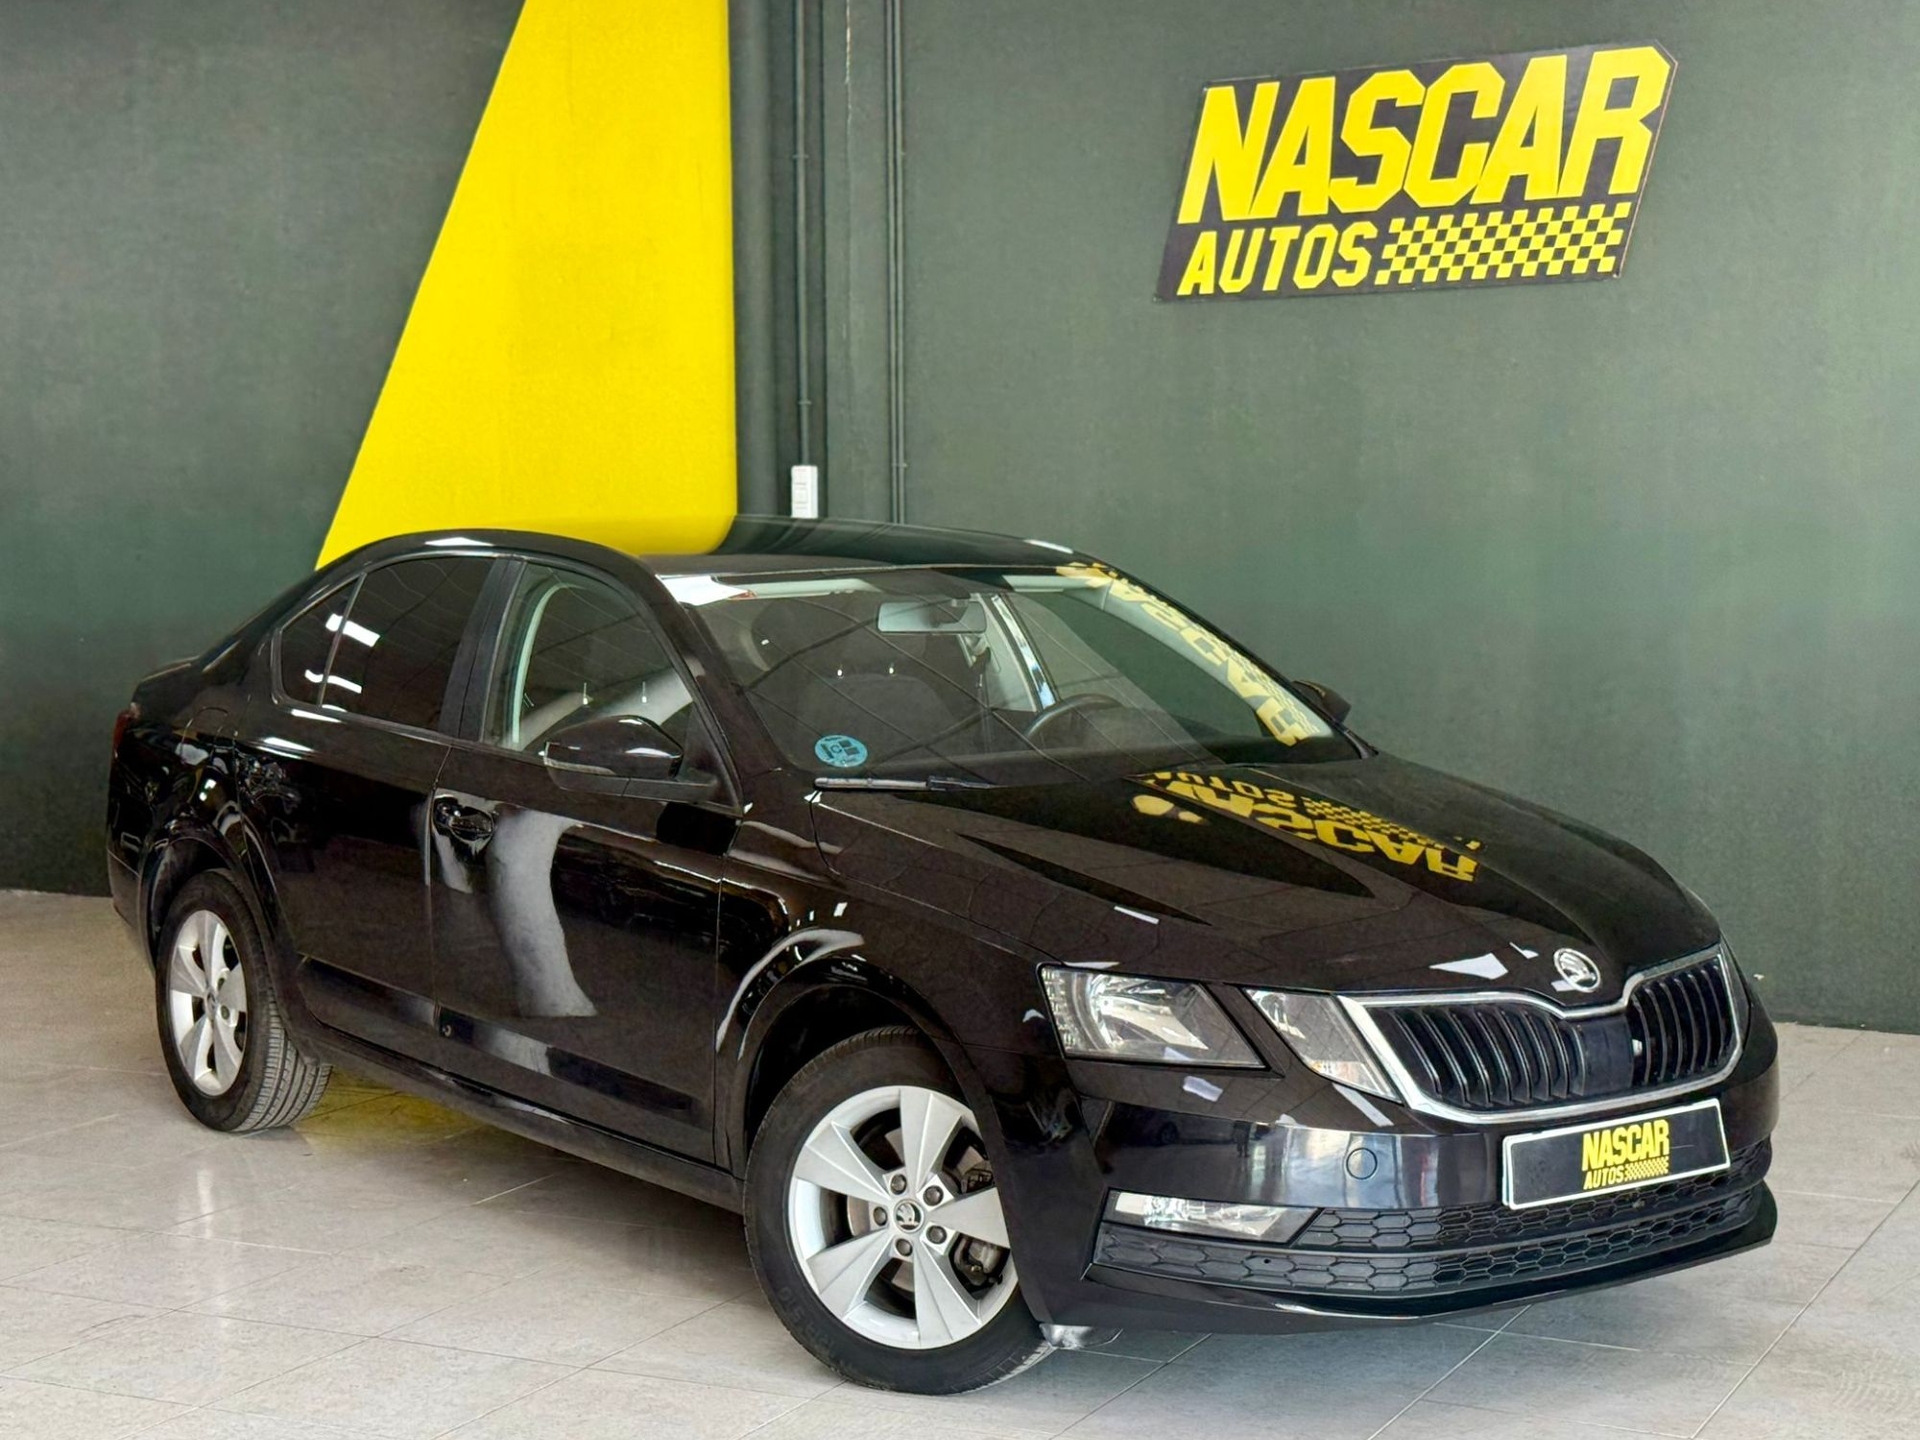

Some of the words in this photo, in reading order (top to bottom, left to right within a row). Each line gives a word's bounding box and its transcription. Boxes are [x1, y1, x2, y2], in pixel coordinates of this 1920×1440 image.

[1177, 46, 1671, 224] NASCAR
[1176, 221, 1378, 295] AUTOS
[1582, 1119, 1670, 1171] NASCAR
[1583, 1165, 1625, 1190] AUTOS
